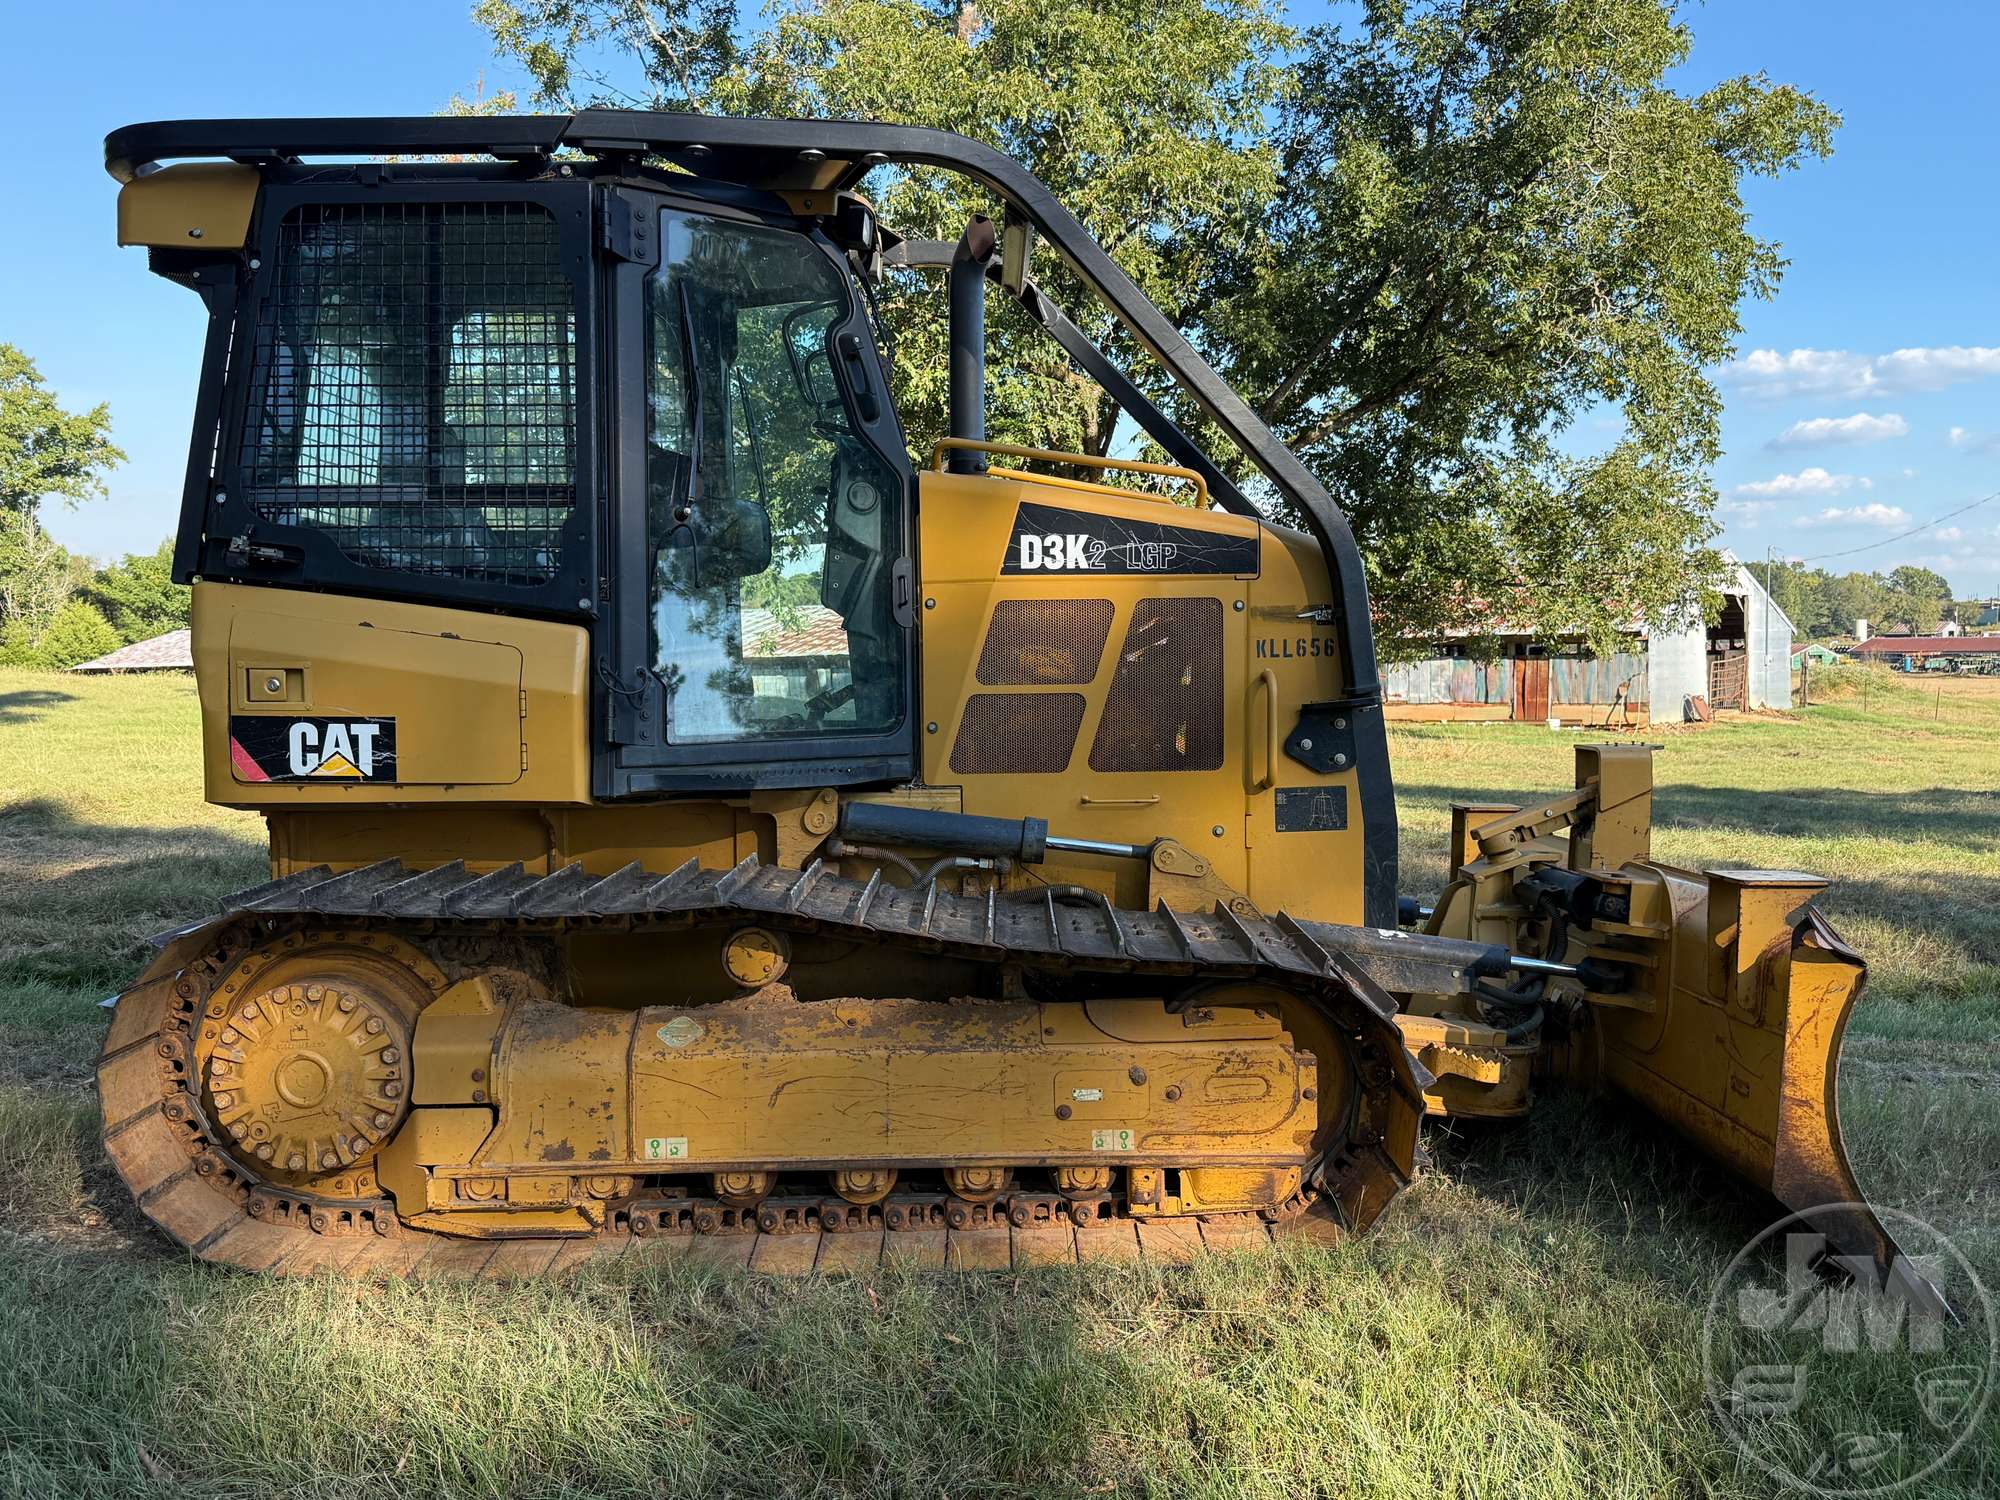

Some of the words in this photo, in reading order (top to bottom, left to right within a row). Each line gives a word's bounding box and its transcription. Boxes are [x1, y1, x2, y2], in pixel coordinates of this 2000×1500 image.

[1126, 542, 1177, 570] LGP
[1256, 638, 1335, 658] KLL656
[289, 722, 380, 777] CAT
